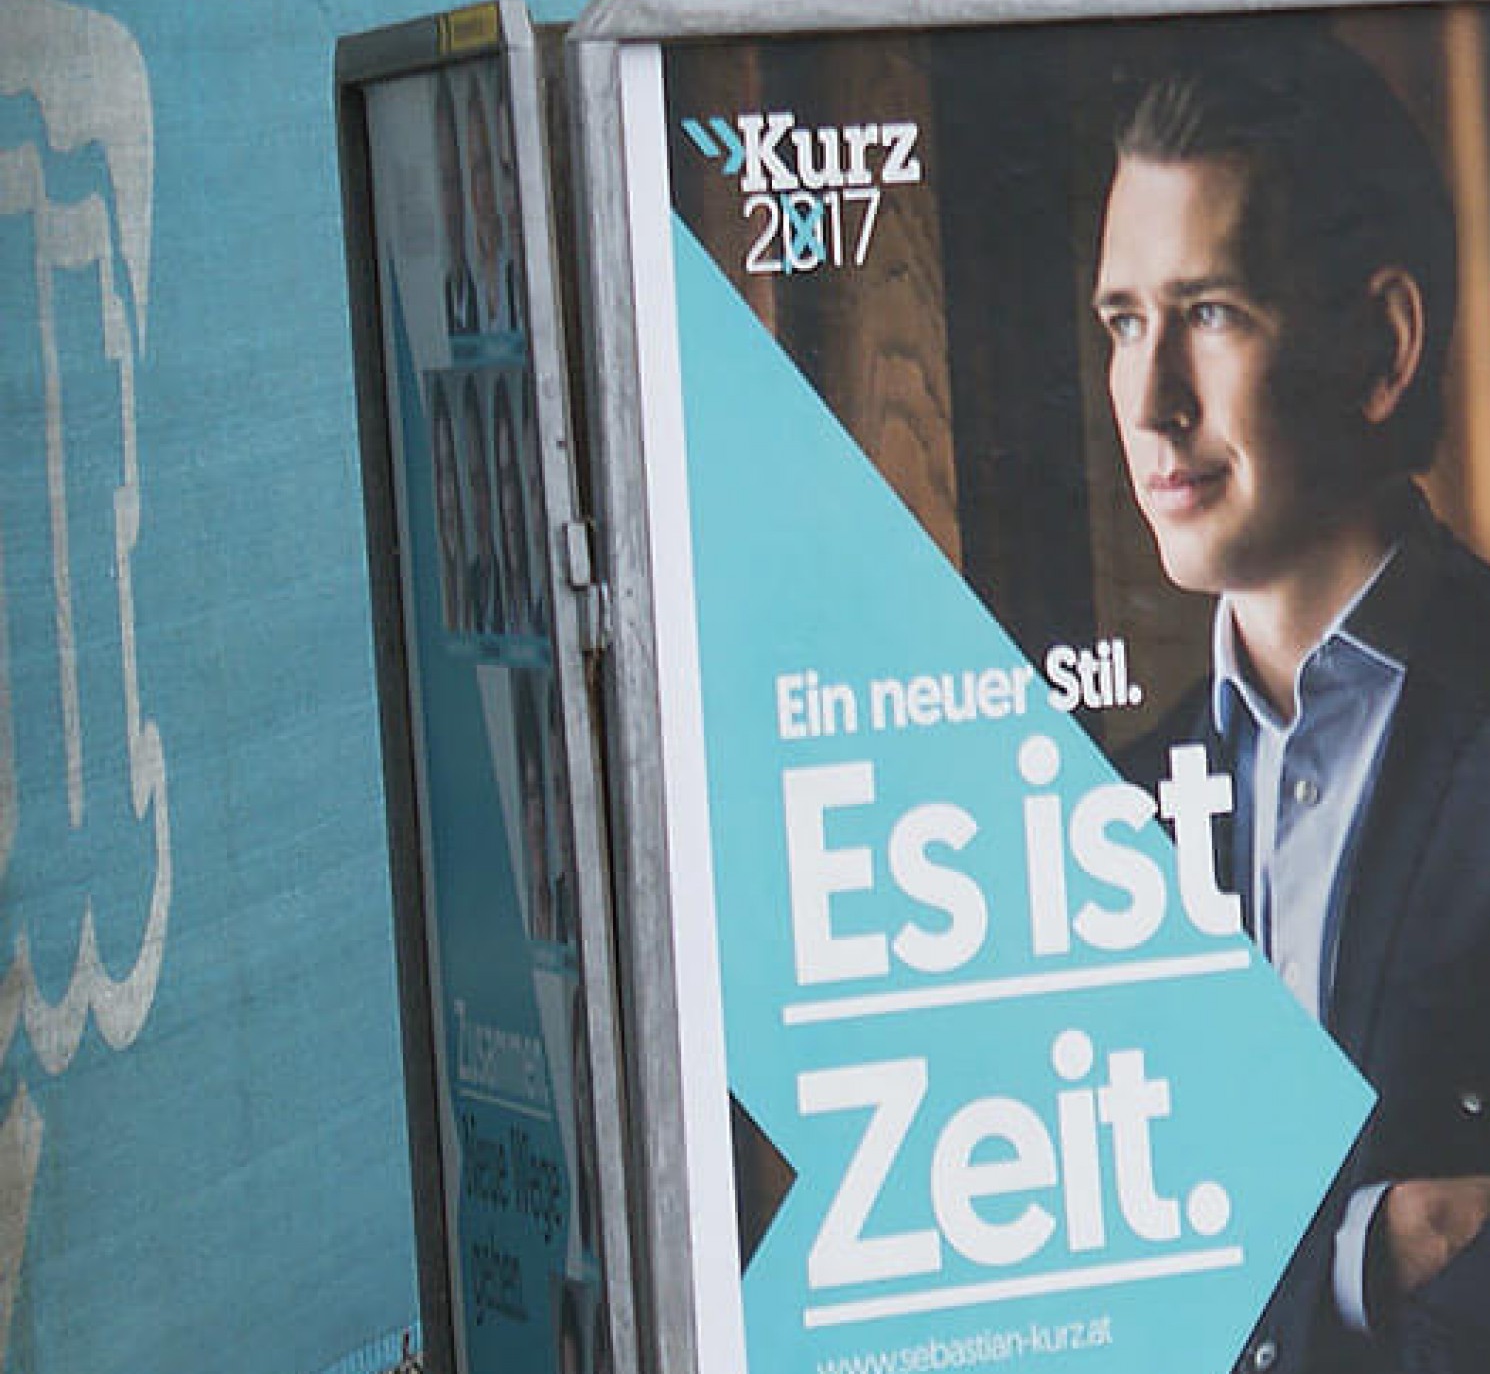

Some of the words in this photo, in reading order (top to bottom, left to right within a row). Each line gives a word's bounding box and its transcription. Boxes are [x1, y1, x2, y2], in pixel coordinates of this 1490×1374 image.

[737, 112, 921, 192] Kurz
[776, 668, 856, 739] Ein
[872, 666, 1033, 730] neuer
[1045, 638, 1143, 713] Stil.
[782, 760, 989, 986] Es
[1017, 733, 1244, 957] ist
[797, 1029, 1231, 1291] Zeit.
